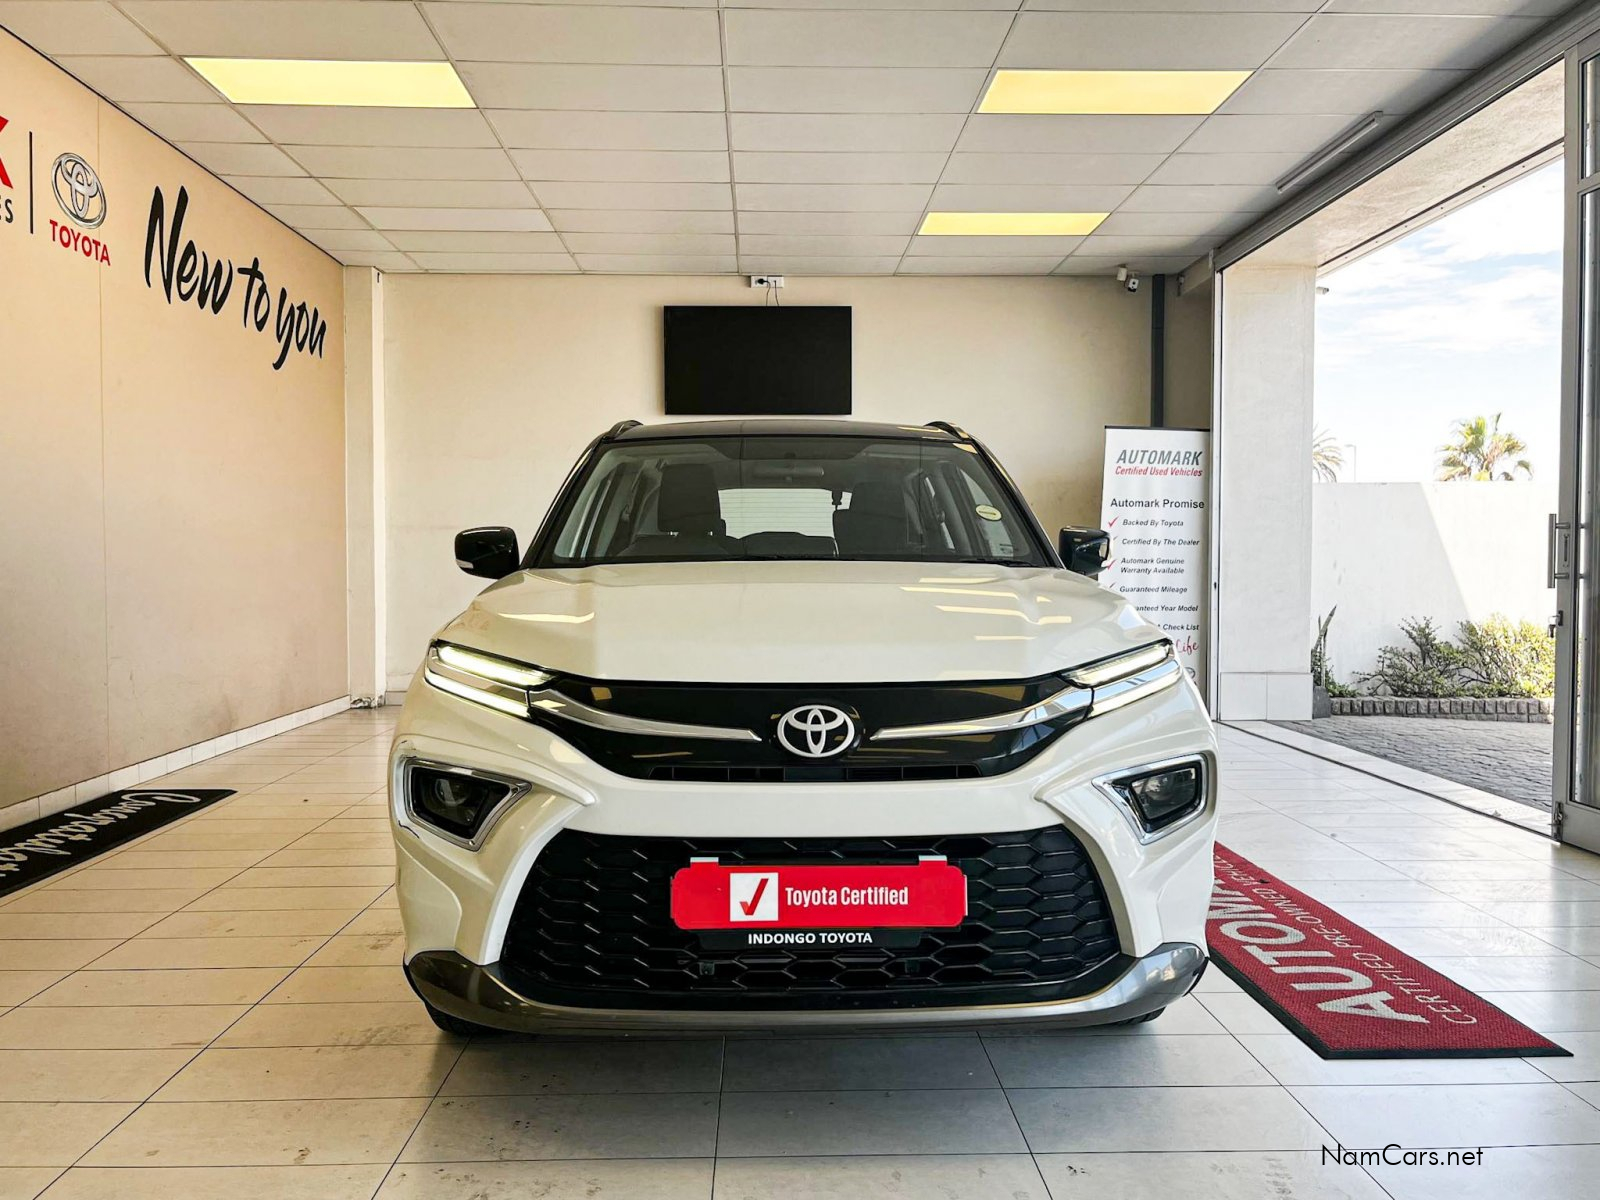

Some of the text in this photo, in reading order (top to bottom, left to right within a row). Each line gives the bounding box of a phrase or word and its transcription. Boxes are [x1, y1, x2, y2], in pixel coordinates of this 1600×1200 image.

[49, 219, 111, 266] TOYOTA
[144, 185, 327, 370] New to you
[1116, 449, 1203, 466] AUTOMARK
[1115, 466, 1203, 477] Certified Used Vehicles
[1110, 498, 1205, 509] Automark Promise
[1150, 520, 1159, 528] By
[1161, 586, 1188, 594] Mileage
[785, 887, 909, 907] Toyota Certified
[1252, 887, 1363, 949] PRE-OWNED
[748, 932, 873, 945] INDONGO TOYOTA
[1352, 951, 1478, 1025] CERTIFIED
